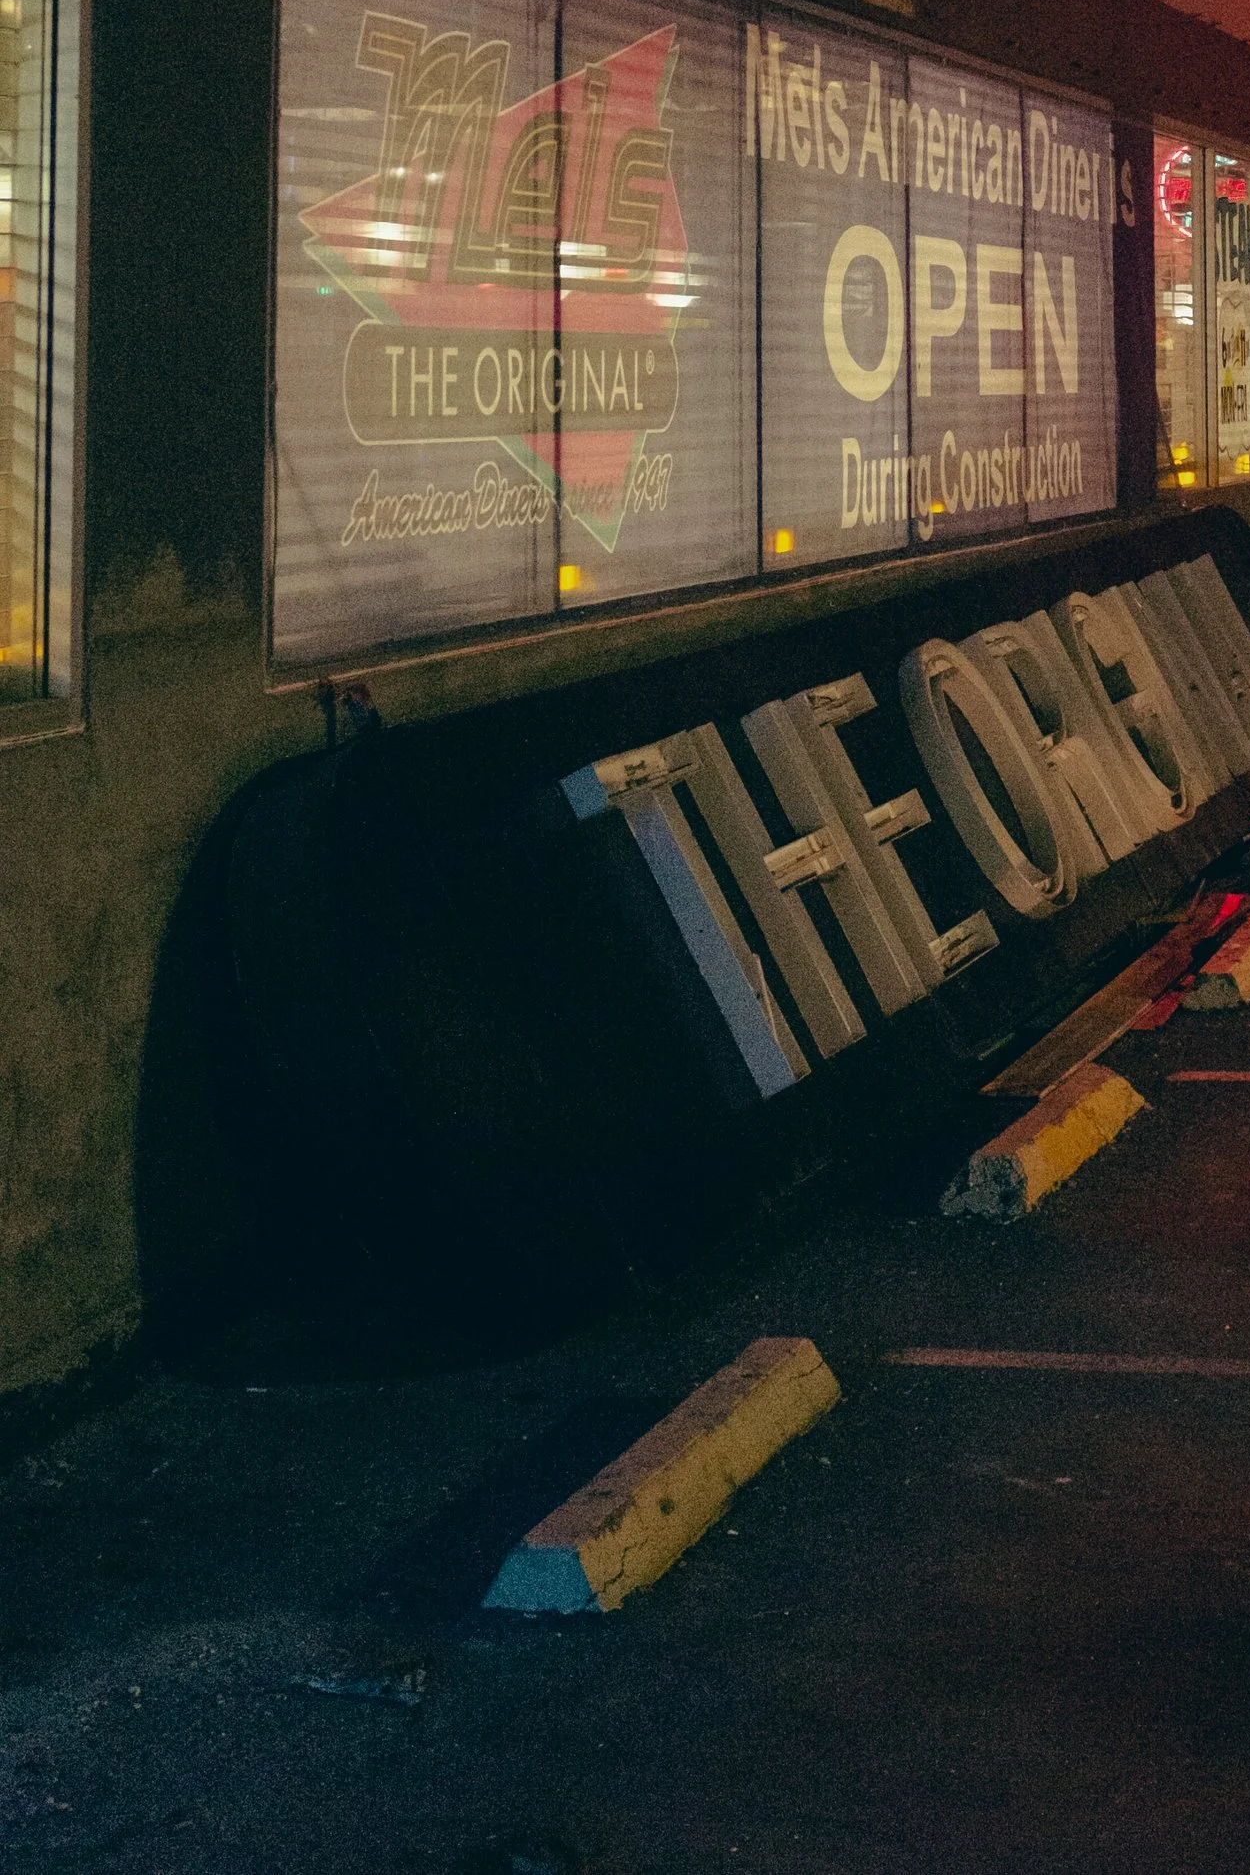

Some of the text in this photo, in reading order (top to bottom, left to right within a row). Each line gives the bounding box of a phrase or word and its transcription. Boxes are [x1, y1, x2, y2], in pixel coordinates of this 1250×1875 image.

[746, 23, 850, 176] Mels
[858, 60, 1024, 208] American
[1029, 109, 1101, 221] Diner
[385, 345, 459, 417] THE
[822, 224, 1080, 402] OPEN
[342, 469, 472, 546] American
[840, 424, 1084, 542] During Construction
[557, 670, 1000, 1101] THE
